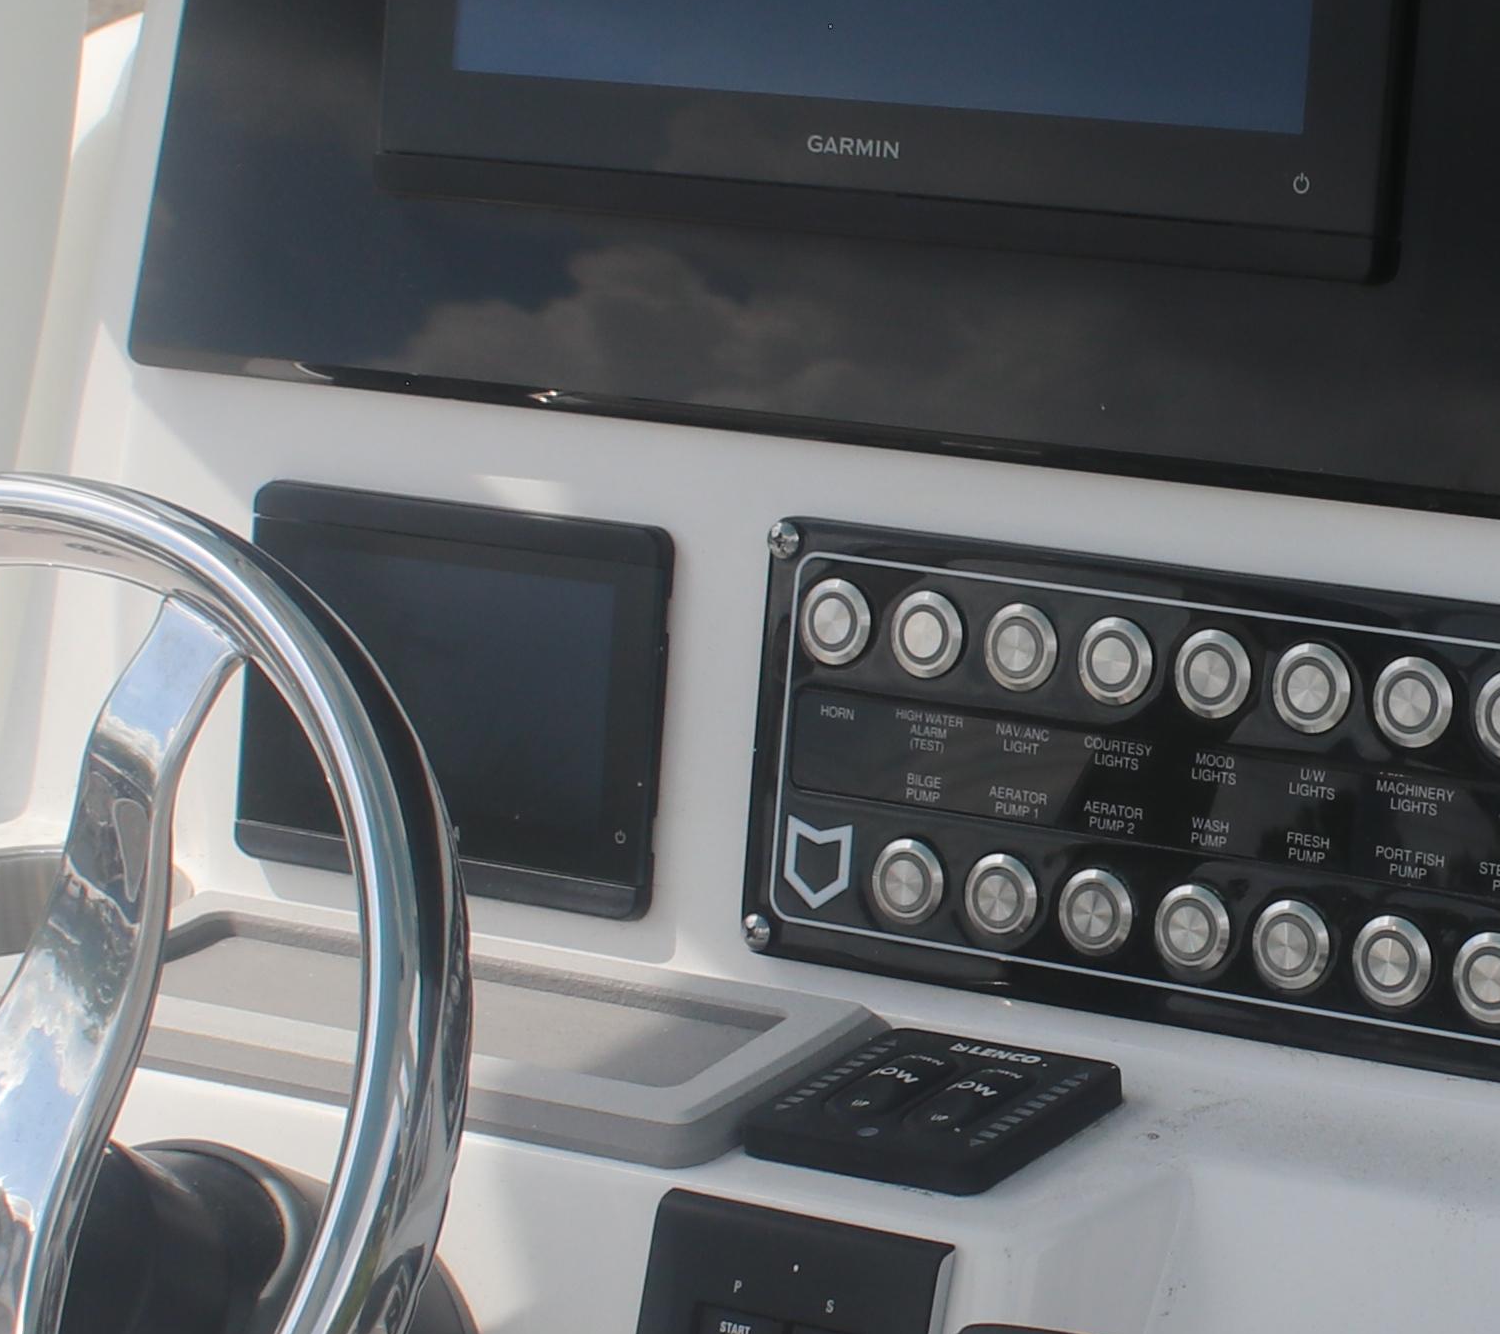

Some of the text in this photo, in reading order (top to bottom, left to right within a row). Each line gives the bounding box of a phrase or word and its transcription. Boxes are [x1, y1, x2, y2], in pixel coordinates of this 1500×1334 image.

[807, 134, 900, 159] GARMIN
[819, 704, 854, 720] HORN
[895, 708, 963, 728] HIGH WATER
[909, 723, 947, 740] ALARM
[995, 722, 1049, 742] NAV/ANC
[909, 737, 944, 753] (TEST)
[1002, 738, 1039, 755] LIGHT
[1083, 735, 1152, 756] COURTESY
[1093, 752, 1139, 771] LIGHTS
[1195, 752, 1235, 769] MOOD
[906, 771, 941, 790] BILGE
[1190, 767, 1237, 786] LIGHTS
[1299, 767, 1326, 782] U/W
[905, 786, 940, 802] PUMP
[988, 785, 1047, 805] AERATOR
[1288, 781, 1335, 800] LIGHTS
[1376, 779, 1455, 802] MACHINERY
[994, 800, 1038, 818] PUMP 1
[1083, 799, 1143, 820] AERATOR
[1389, 797, 1437, 816] LIGHTS
[1088, 815, 1135, 834] PUMP 2
[1191, 816, 1229, 833] WASH
[1190, 831, 1227, 847] PUMP
[1285, 830, 1330, 849] FRESH
[1287, 846, 1325, 863] PUMP
[1375, 844, 1445, 868] PORT FISH
[1389, 862, 1427, 879] PUMP
[967, 1043, 1043, 1065] LENCO
[733, 1279, 742, 1293] P
[825, 1299, 834, 1314] S
